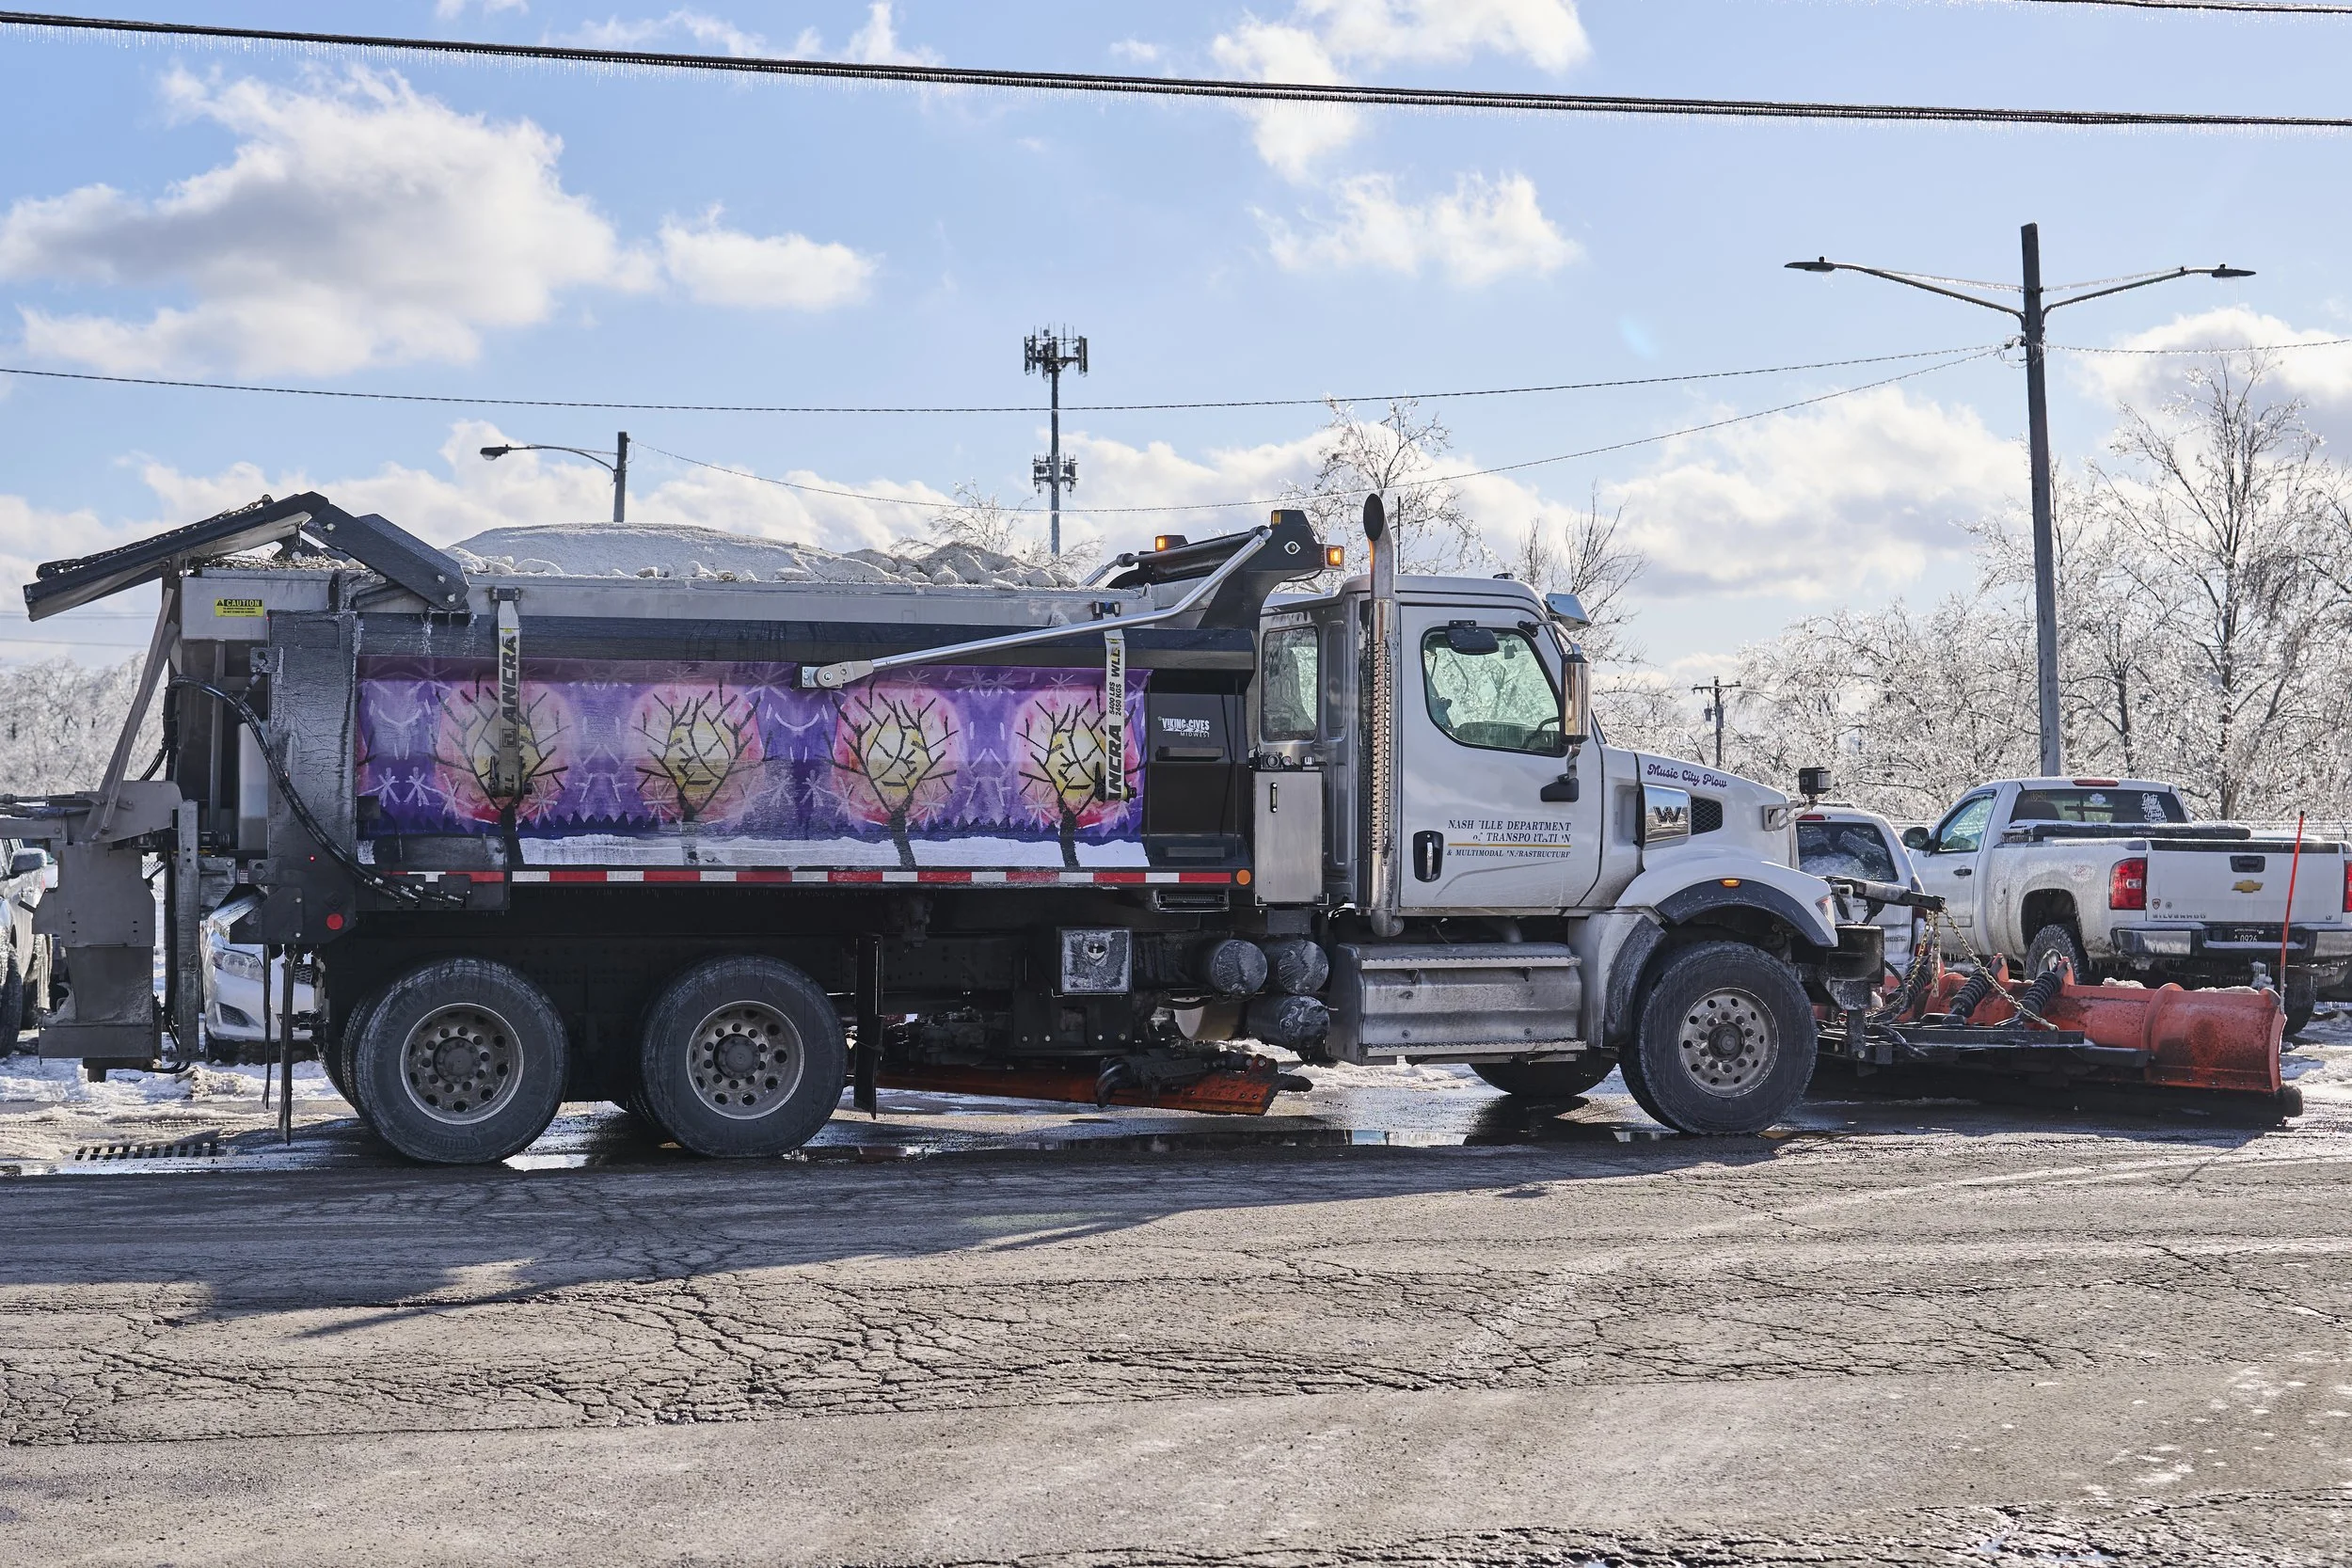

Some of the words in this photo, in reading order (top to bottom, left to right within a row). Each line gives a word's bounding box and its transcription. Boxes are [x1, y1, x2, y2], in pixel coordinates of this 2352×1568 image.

[502, 635, 516, 725] ANCRA
[504, 774, 515, 797] LL
[1647, 763, 1678, 779] Music
[1682, 769, 1700, 786] City
[1702, 773, 1727, 787] Plow
[1448, 820, 1503, 830] NASHILLE
[1506, 821, 1571, 831] DEPARTMENT
[1472, 832, 1484, 841] o
[1486, 832, 1571, 842] TRANSPOTTIN
